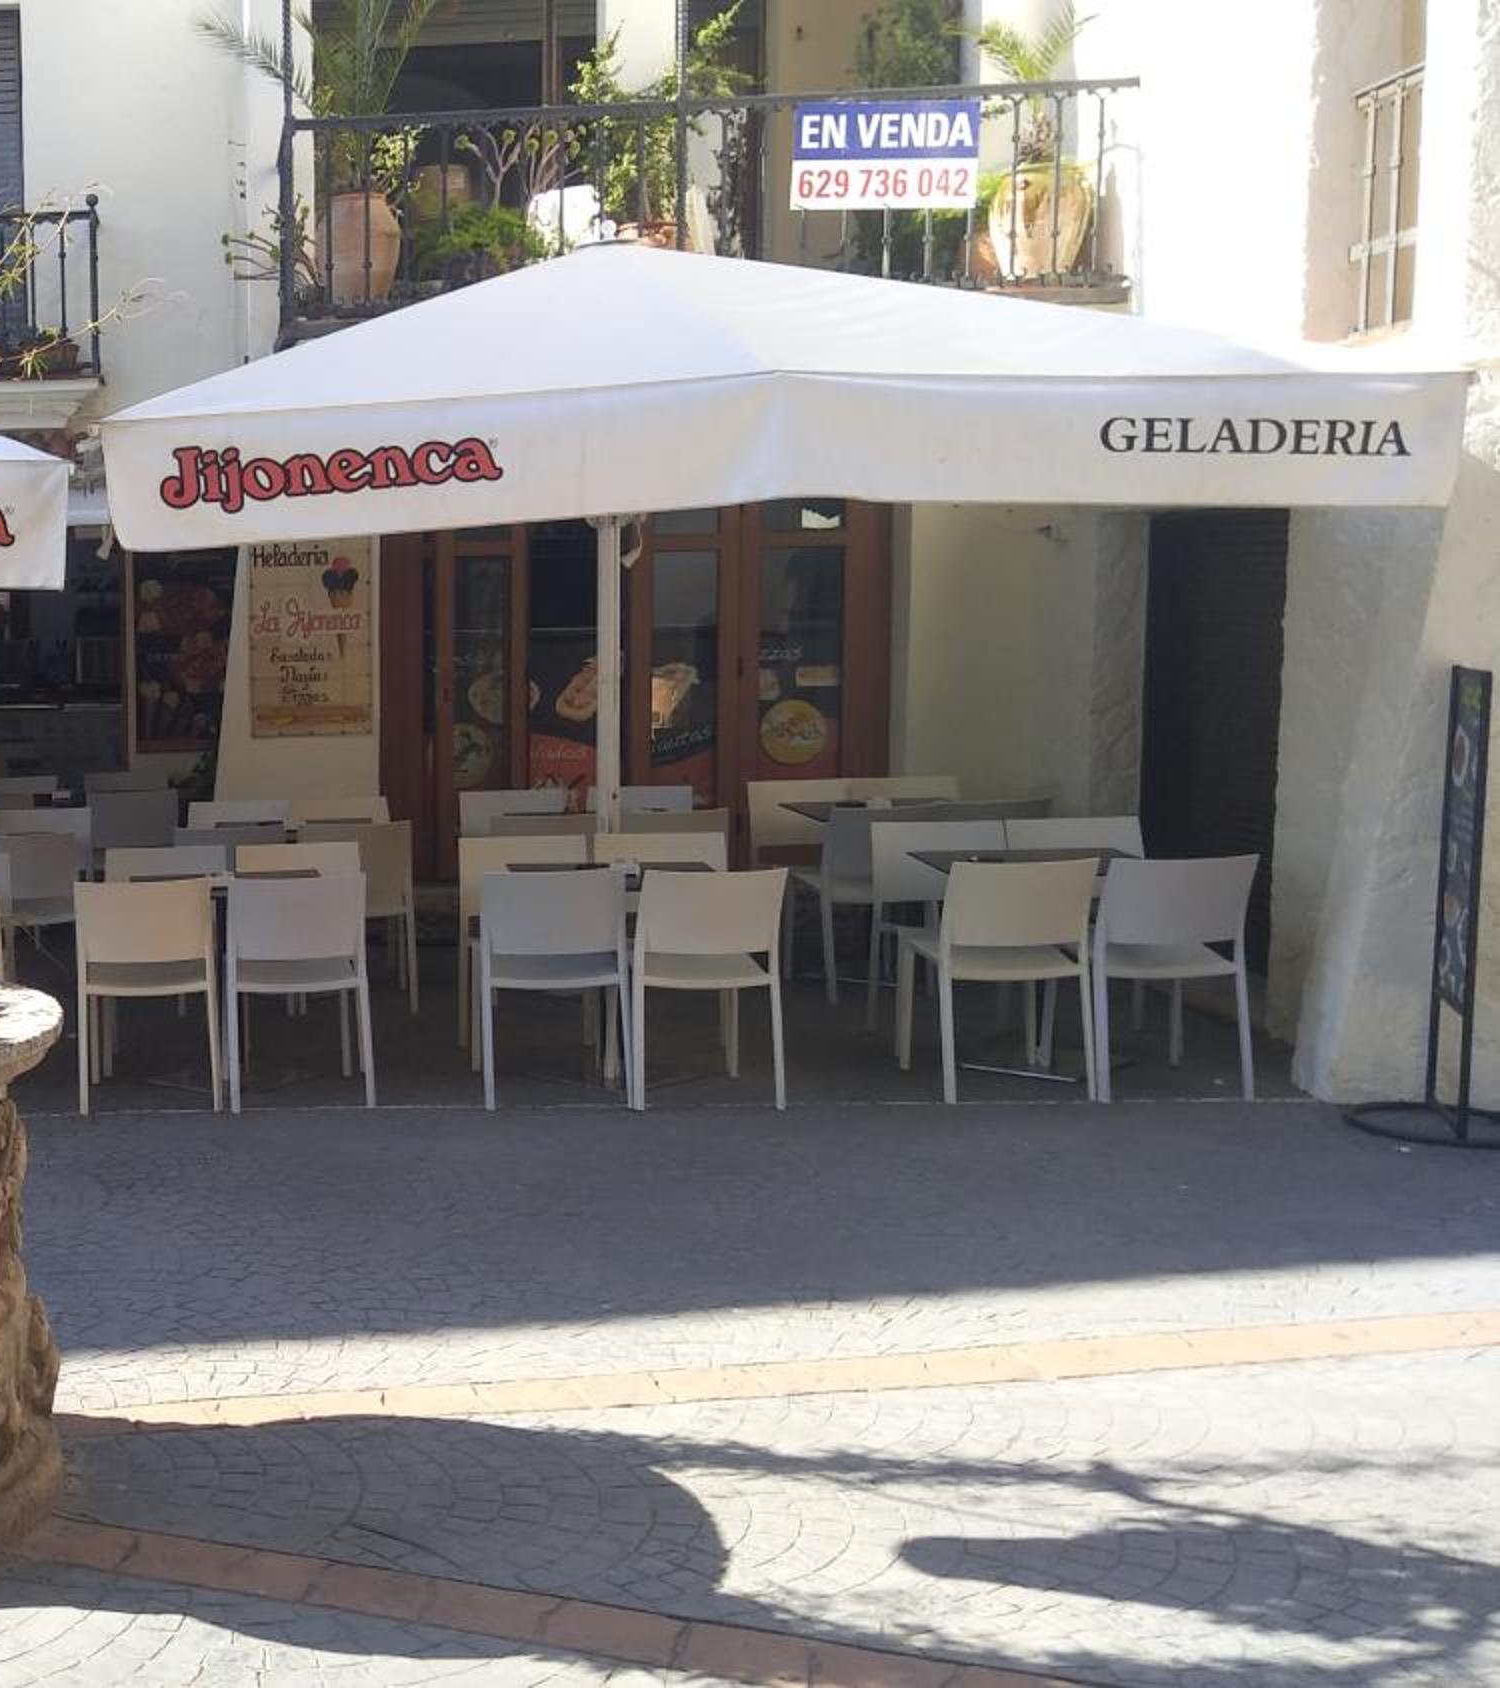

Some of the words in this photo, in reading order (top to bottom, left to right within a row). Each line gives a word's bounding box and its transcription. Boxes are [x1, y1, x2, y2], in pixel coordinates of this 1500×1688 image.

[802, 114, 847, 149] EN
[857, 112, 973, 149] VENDA
[799, 169, 849, 198] 629
[859, 168, 907, 198] 736
[918, 167, 969, 197] 042
[1100, 416, 1411, 456] GELADERIA
[160, 437, 503, 513] Jijonenca
